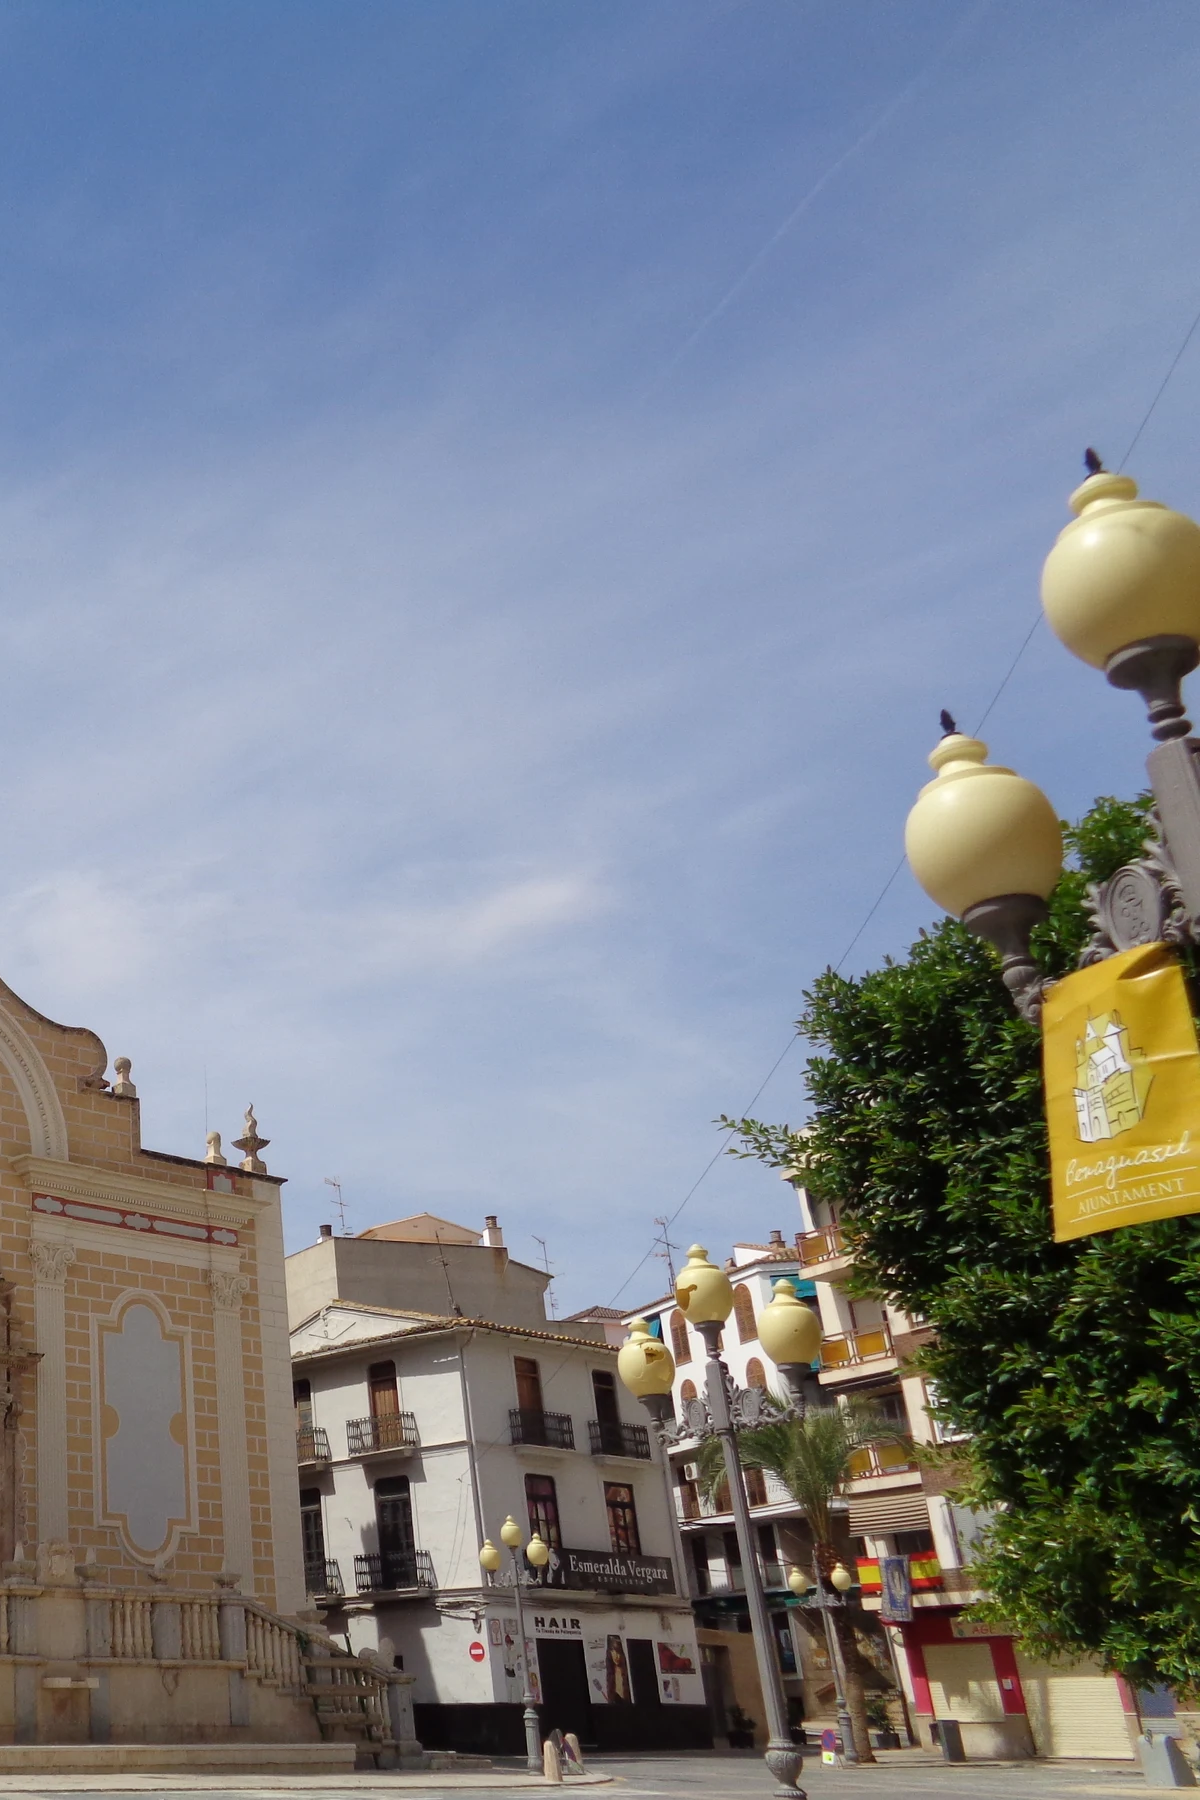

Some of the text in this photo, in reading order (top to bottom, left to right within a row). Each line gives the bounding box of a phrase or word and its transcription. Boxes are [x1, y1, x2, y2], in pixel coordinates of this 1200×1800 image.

[1078, 1178, 1184, 1214] AJUNTAMENT
[569, 1554, 668, 1584] Esmeralda Vergara
[534, 1616, 581, 1629] HAIR
